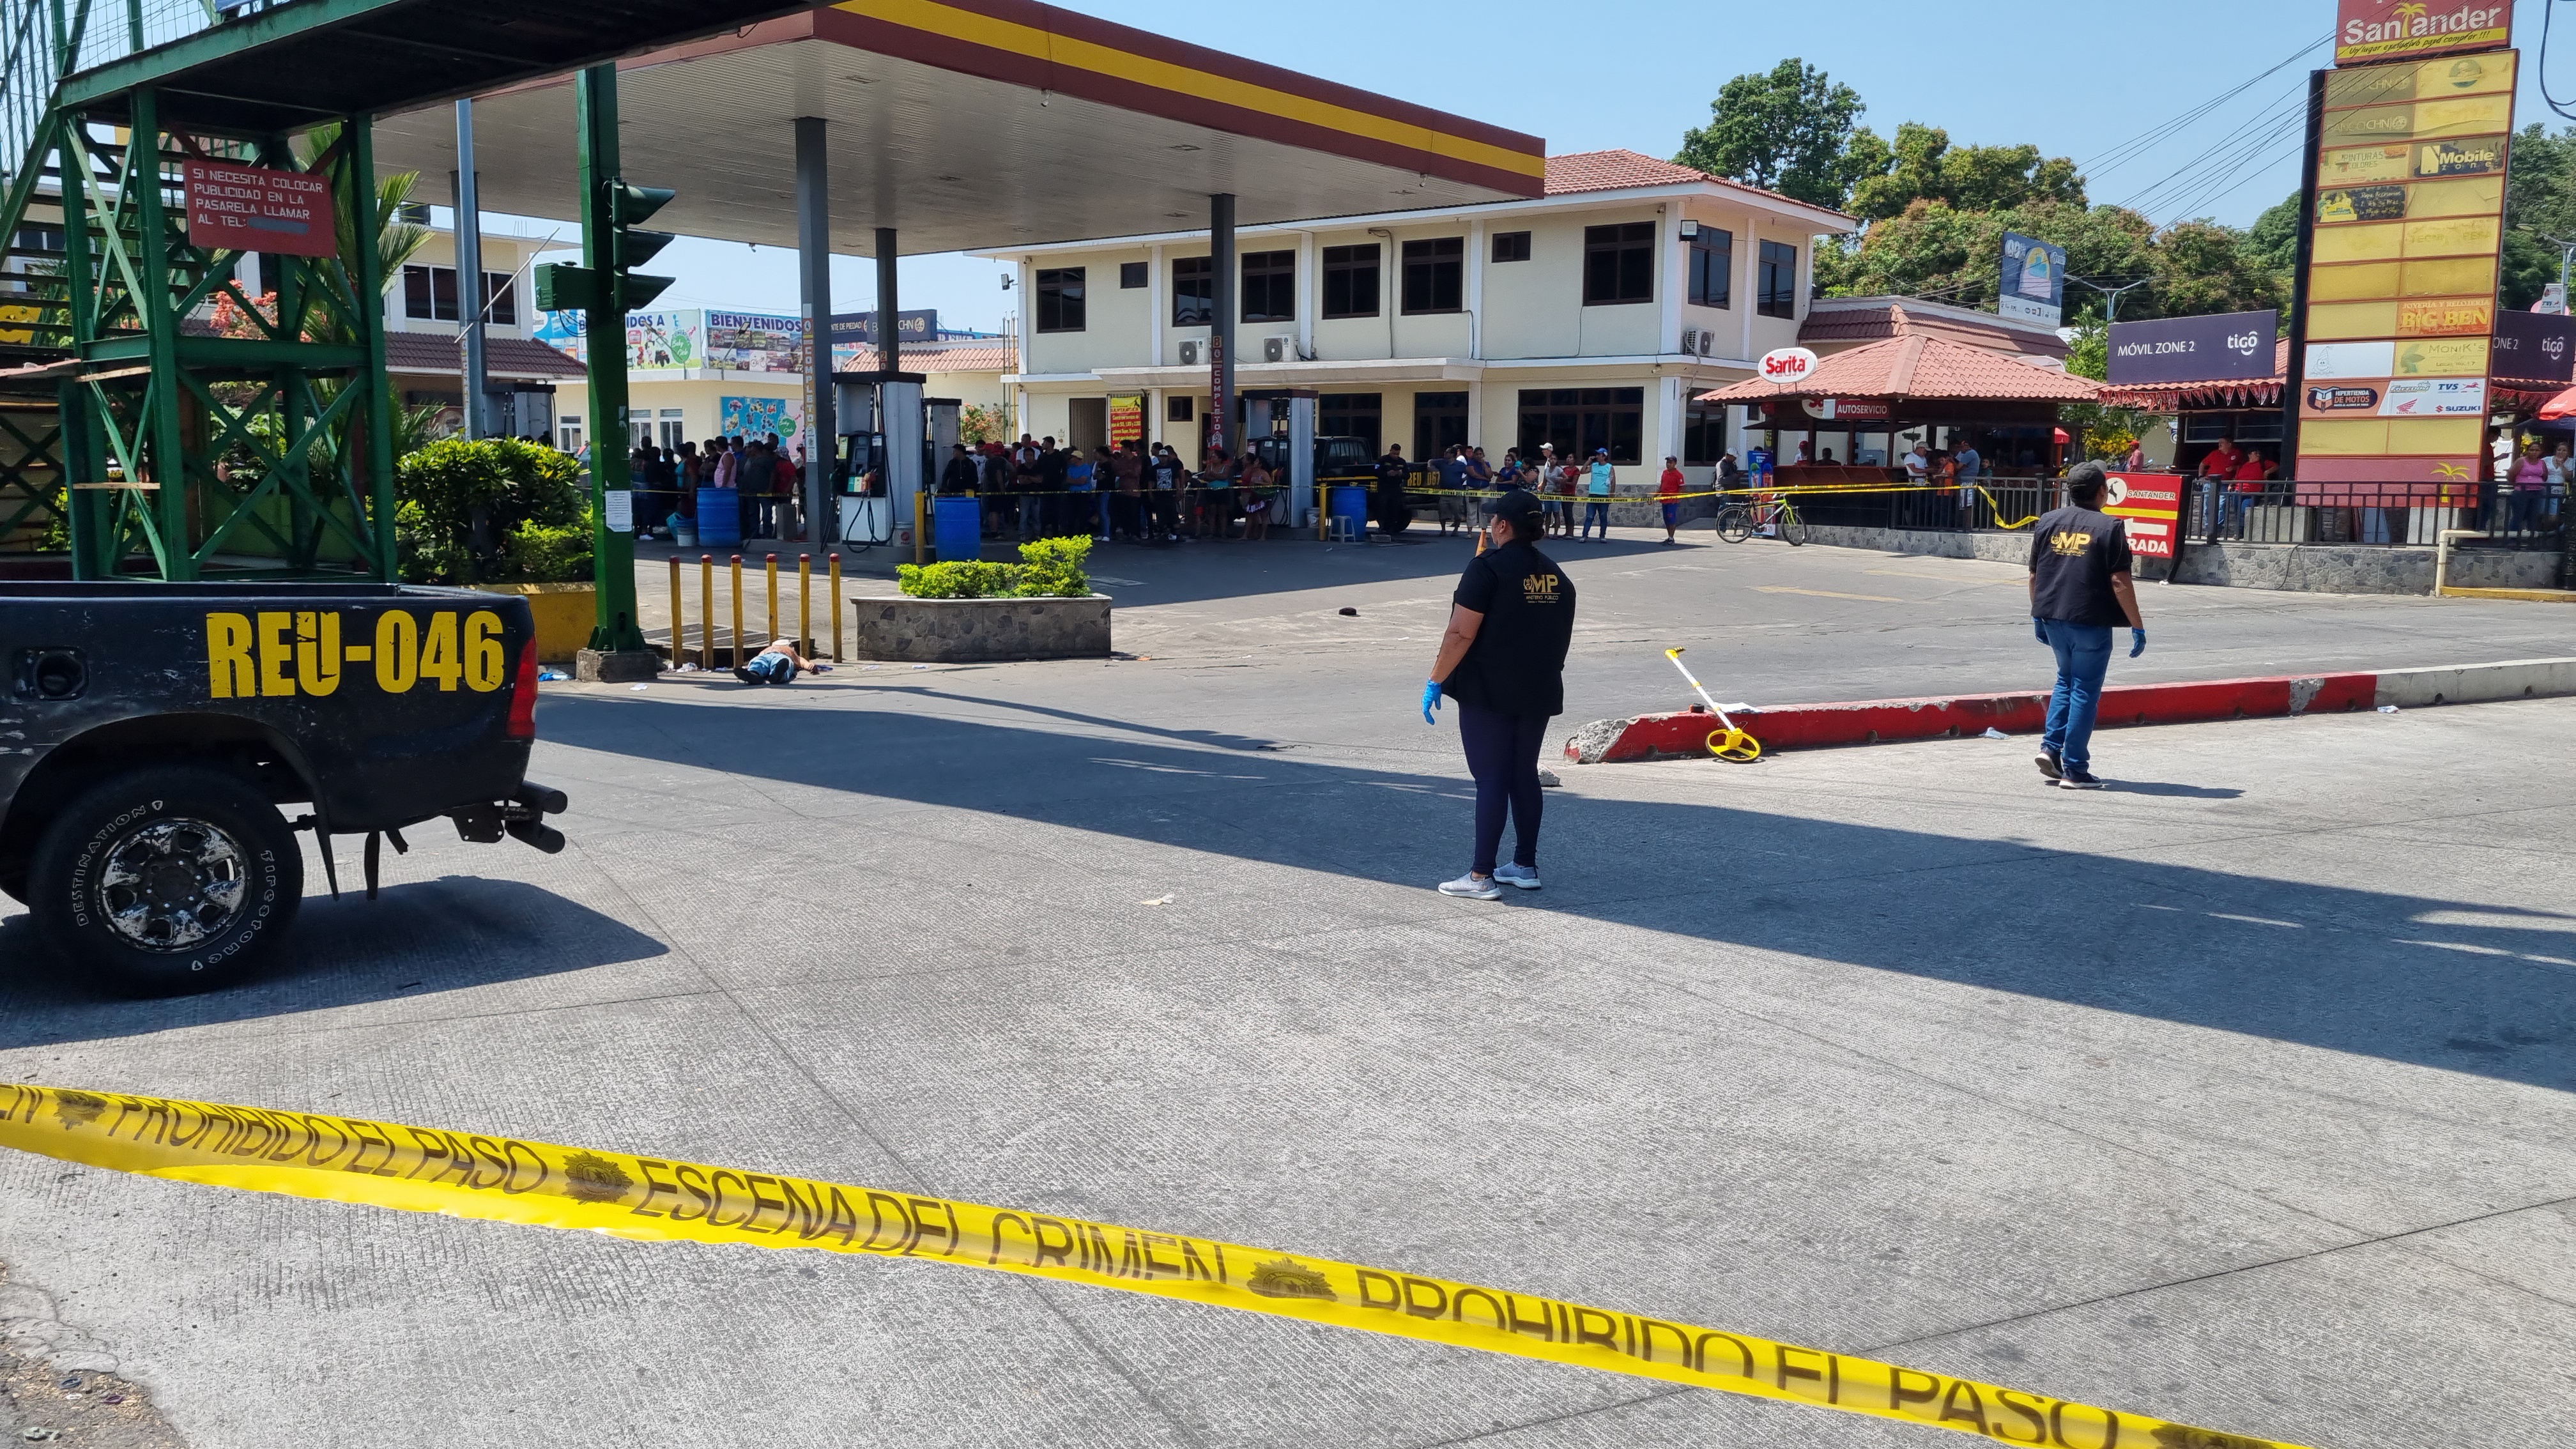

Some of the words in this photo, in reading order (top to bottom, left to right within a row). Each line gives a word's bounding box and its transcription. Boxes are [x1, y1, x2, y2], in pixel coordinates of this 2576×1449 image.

[2344, 5, 2501, 45] Santander
[2361, 45, 2381, 54] lugar
[2444, 33, 2478, 43] comprar
[2439, 149, 2495, 165] Mobile
[194, 168, 204, 179] SI
[210, 170, 266, 187] NECESITA
[273, 178, 323, 193] COLOCAR
[194, 183, 261, 200] PUBLICIDAD
[268, 192, 283, 203] EN
[289, 194, 304, 205] LA
[196, 198, 257, 214] PASARELA
[264, 205, 310, 220] LLAMAR
[197, 213, 213, 225] AL
[220, 215, 247, 227] TEL:
[710, 314, 802, 332] BIENVENIDOS
[2401, 310, 2437, 328] BIG
[2442, 309, 2489, 326] BEN
[2117, 342, 2153, 357] MÓVIL
[2155, 341, 2187, 355] ZONE
[2189, 341, 2195, 352] 2
[2492, 337, 2511, 350] ONE
[2513, 339, 2518, 350] 2
[1765, 355, 1805, 374] Sarita
[1837, 404, 1888, 415] AUTOSERVICIO
[2127, 490, 2175, 500] SANTANDER
[2057, 532, 2090, 549] MP
[2127, 537, 2168, 555] RADA
[1529, 574, 1558, 593] MP
[205, 609, 505, 698] REU-046
[72, 805, 146, 926] DESTINATION
[99, 1092, 348, 1167] PROHIBIDO
[341, 1119, 399, 1177] EL
[404, 1127, 548, 1195] PASO
[629, 1159, 857, 1246] ESCENA
[988, 1211, 1228, 1285] CRIMEN
[1889, 1366, 2120, 1449] PASO
